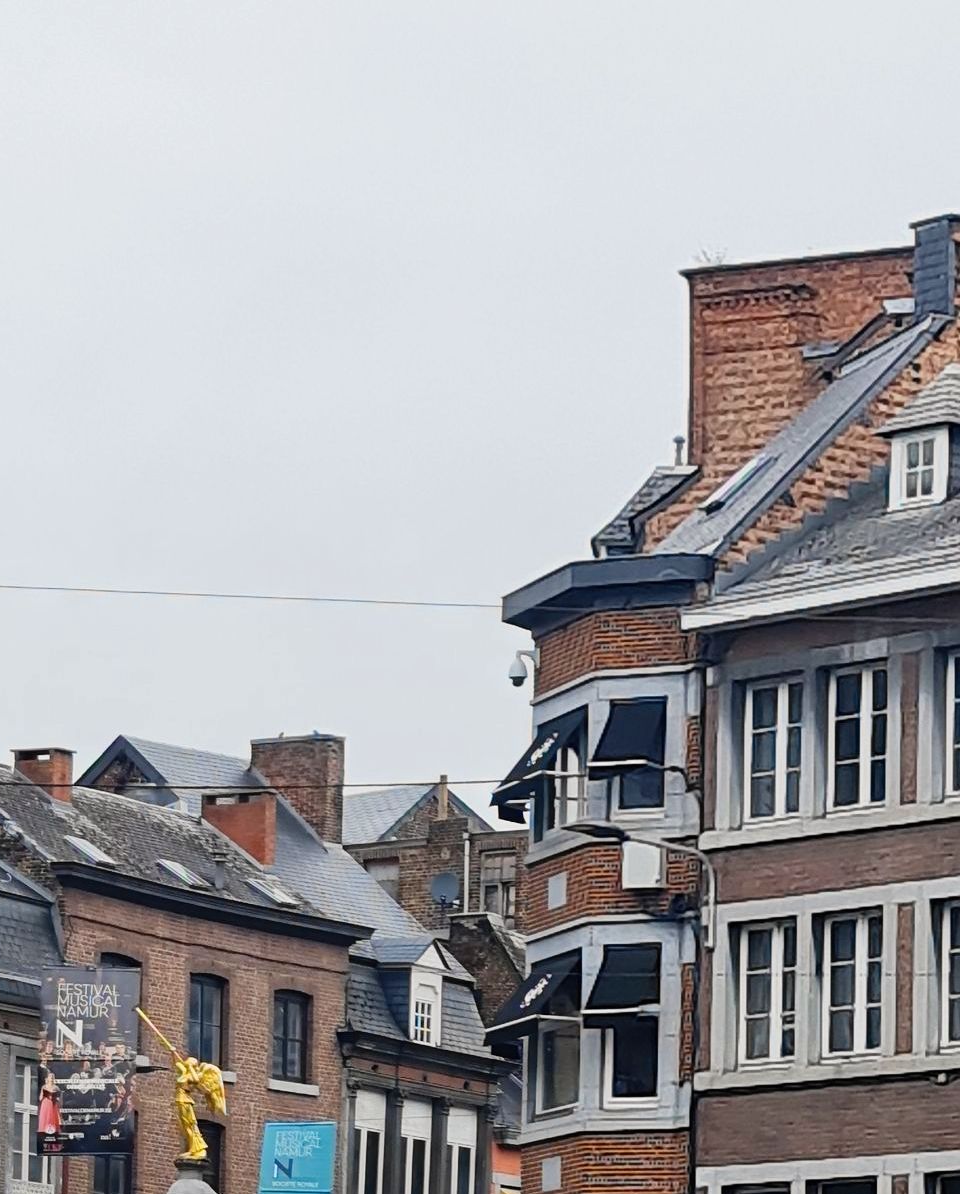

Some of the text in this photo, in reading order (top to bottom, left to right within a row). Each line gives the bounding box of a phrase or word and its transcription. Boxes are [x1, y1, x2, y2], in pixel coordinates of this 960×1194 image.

[58, 983, 121, 997] FESTIVAL
[57, 994, 121, 1008] MUSICAL
[56, 1005, 110, 1019] NAMUR
[56, 1020, 84, 1048] N
[275, 1130, 321, 1141] FESTIVAL
[275, 1138, 321, 1149] MUSICAL
[274, 1146, 313, 1157] NAMUR
[273, 1158, 294, 1179] N
